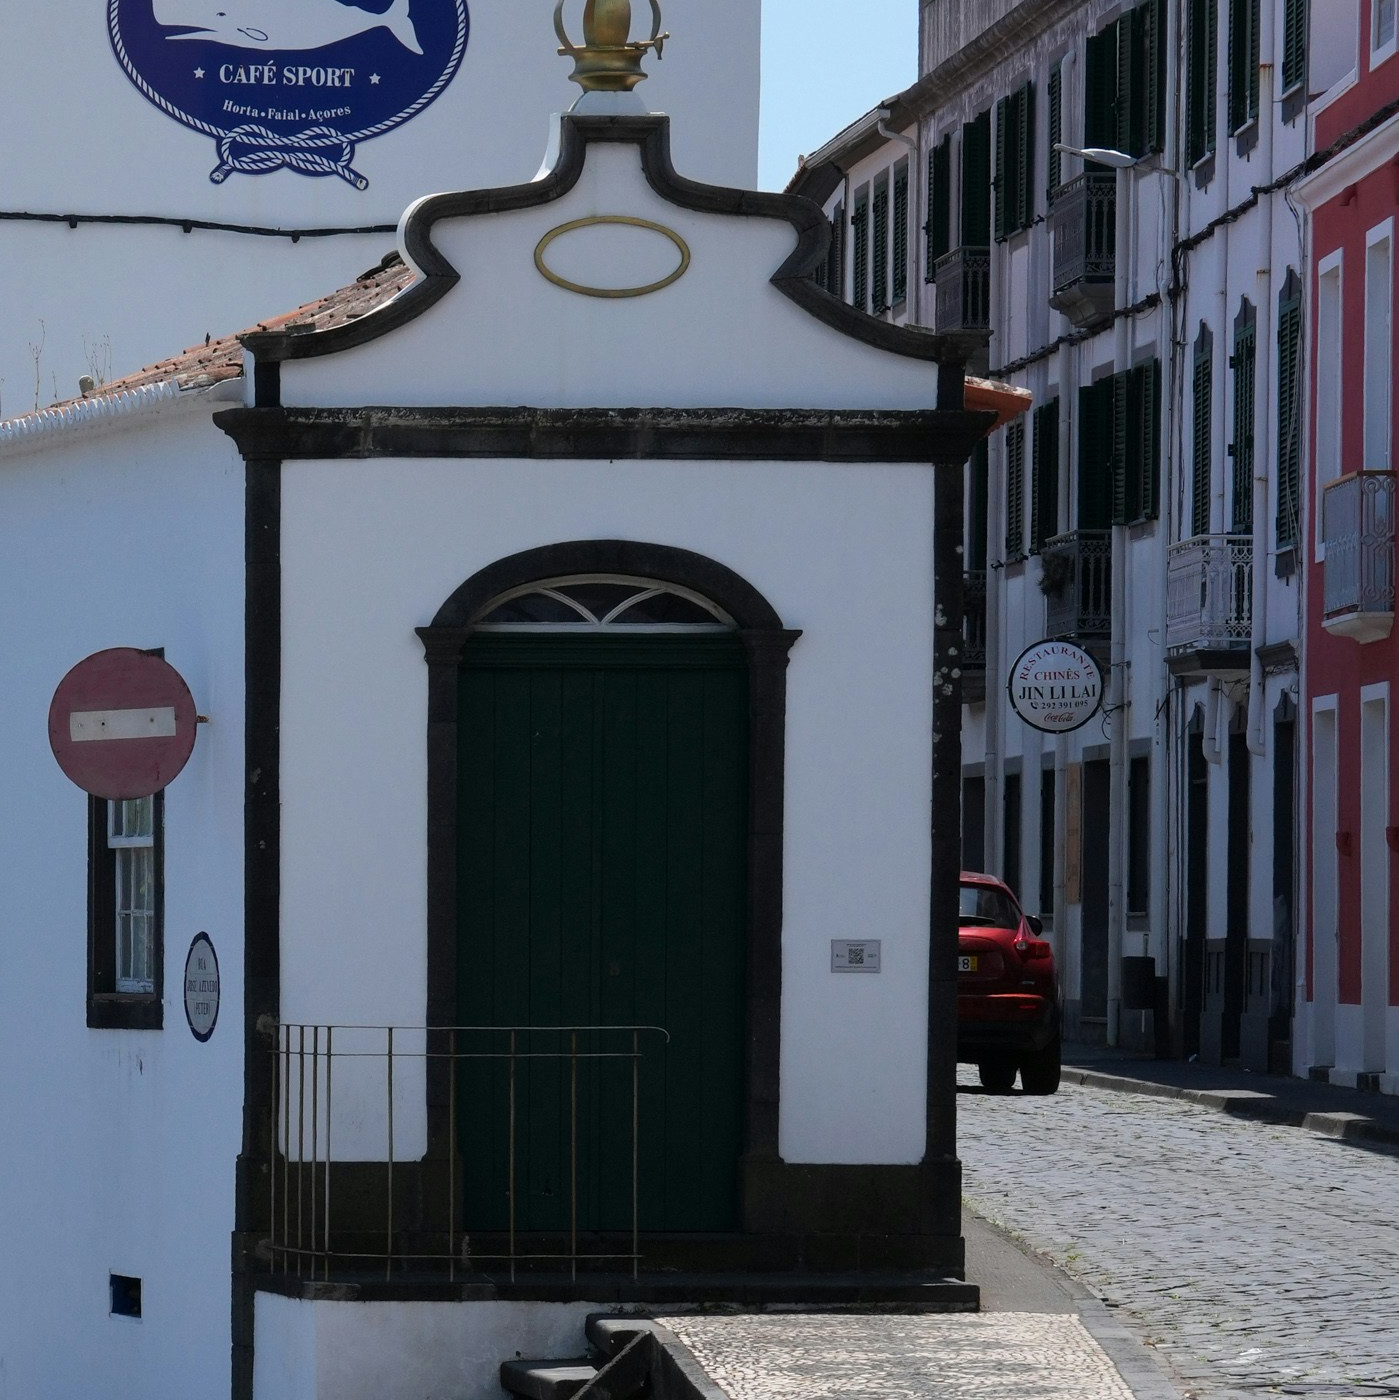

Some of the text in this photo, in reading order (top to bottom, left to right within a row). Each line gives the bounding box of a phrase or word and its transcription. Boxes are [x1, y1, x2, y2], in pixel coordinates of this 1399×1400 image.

[218, 60, 355, 88] CAFÉ SPORT
[222, 99, 351, 123] Horta Faial Açores
[1019, 647, 1096, 681] RESTAURANTE
[1034, 667, 1081, 681] CHINÊS
[1018, 684, 1097, 701] JIN LI LAI
[1041, 702, 1056, 710] 292
